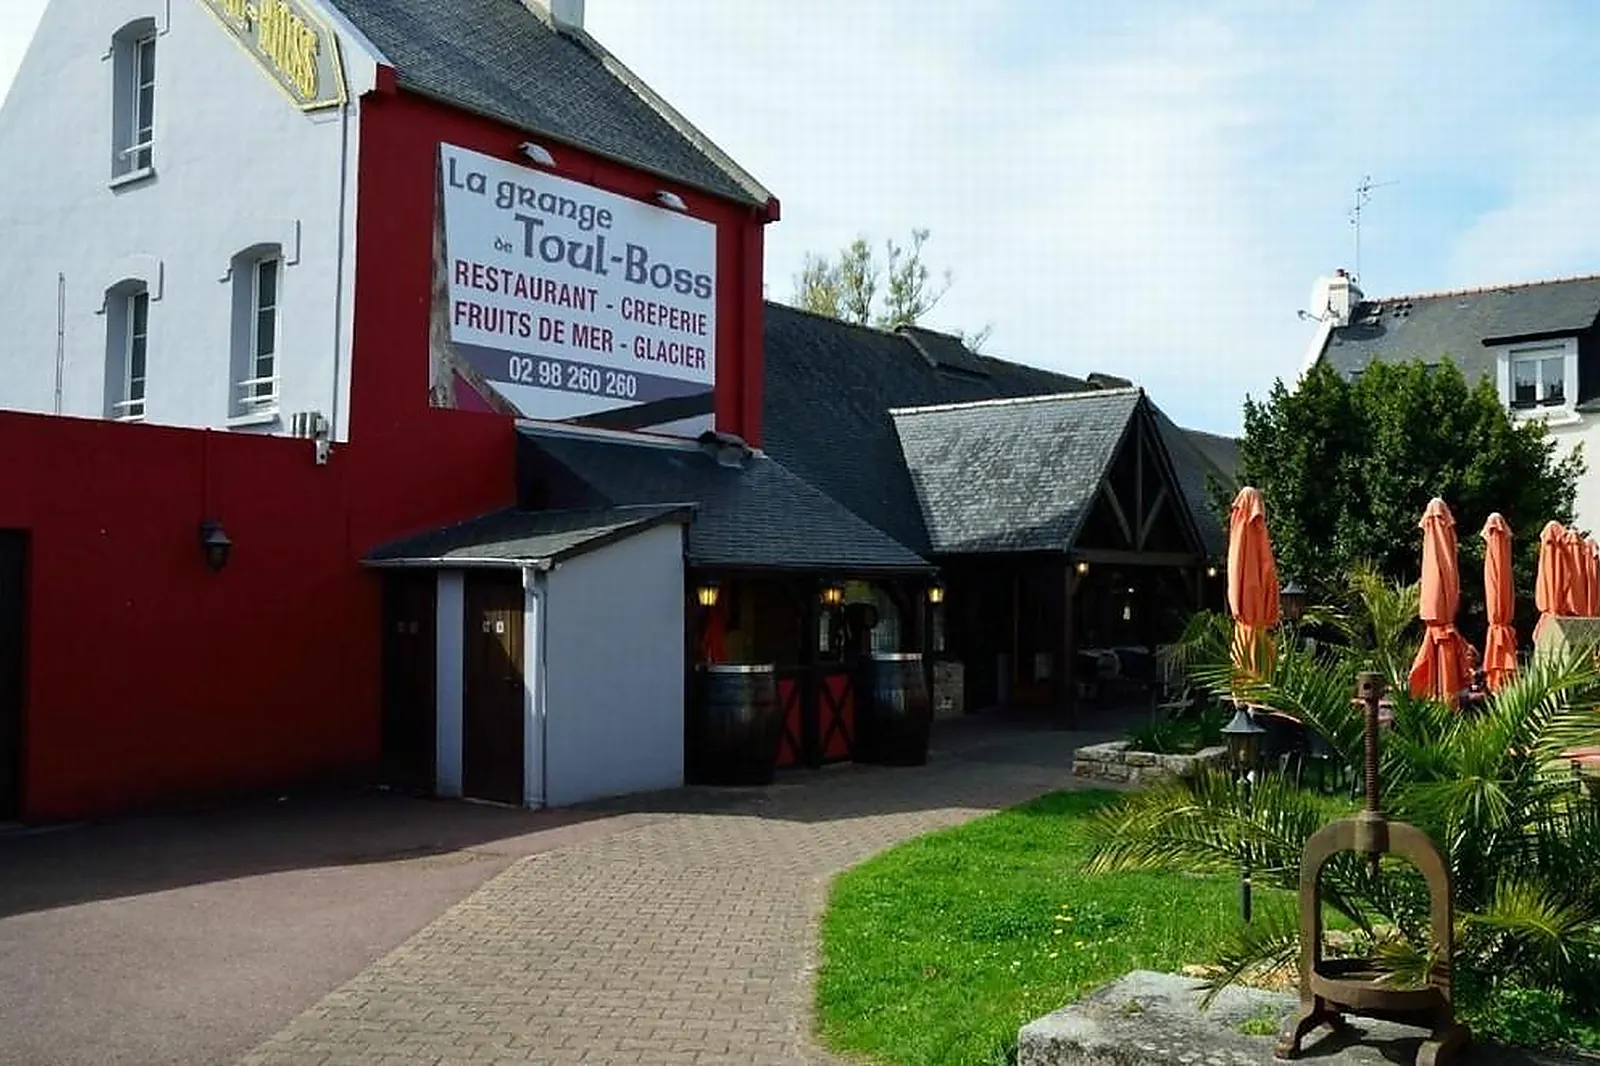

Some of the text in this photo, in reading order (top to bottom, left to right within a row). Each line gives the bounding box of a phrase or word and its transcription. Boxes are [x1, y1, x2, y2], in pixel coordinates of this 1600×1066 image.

[449, 157, 487, 194] La
[514, 213, 712, 299] Toul-Boss
[455, 259, 598, 313] RESTAURANT
[621, 297, 707, 336] CREPERIE
[454, 300, 532, 338] FRUITS
[538, 317, 564, 344] DE
[572, 321, 613, 353] MER
[633, 335, 706, 370] GLACIER
[508, 356, 637, 398] 02 98 260 260
